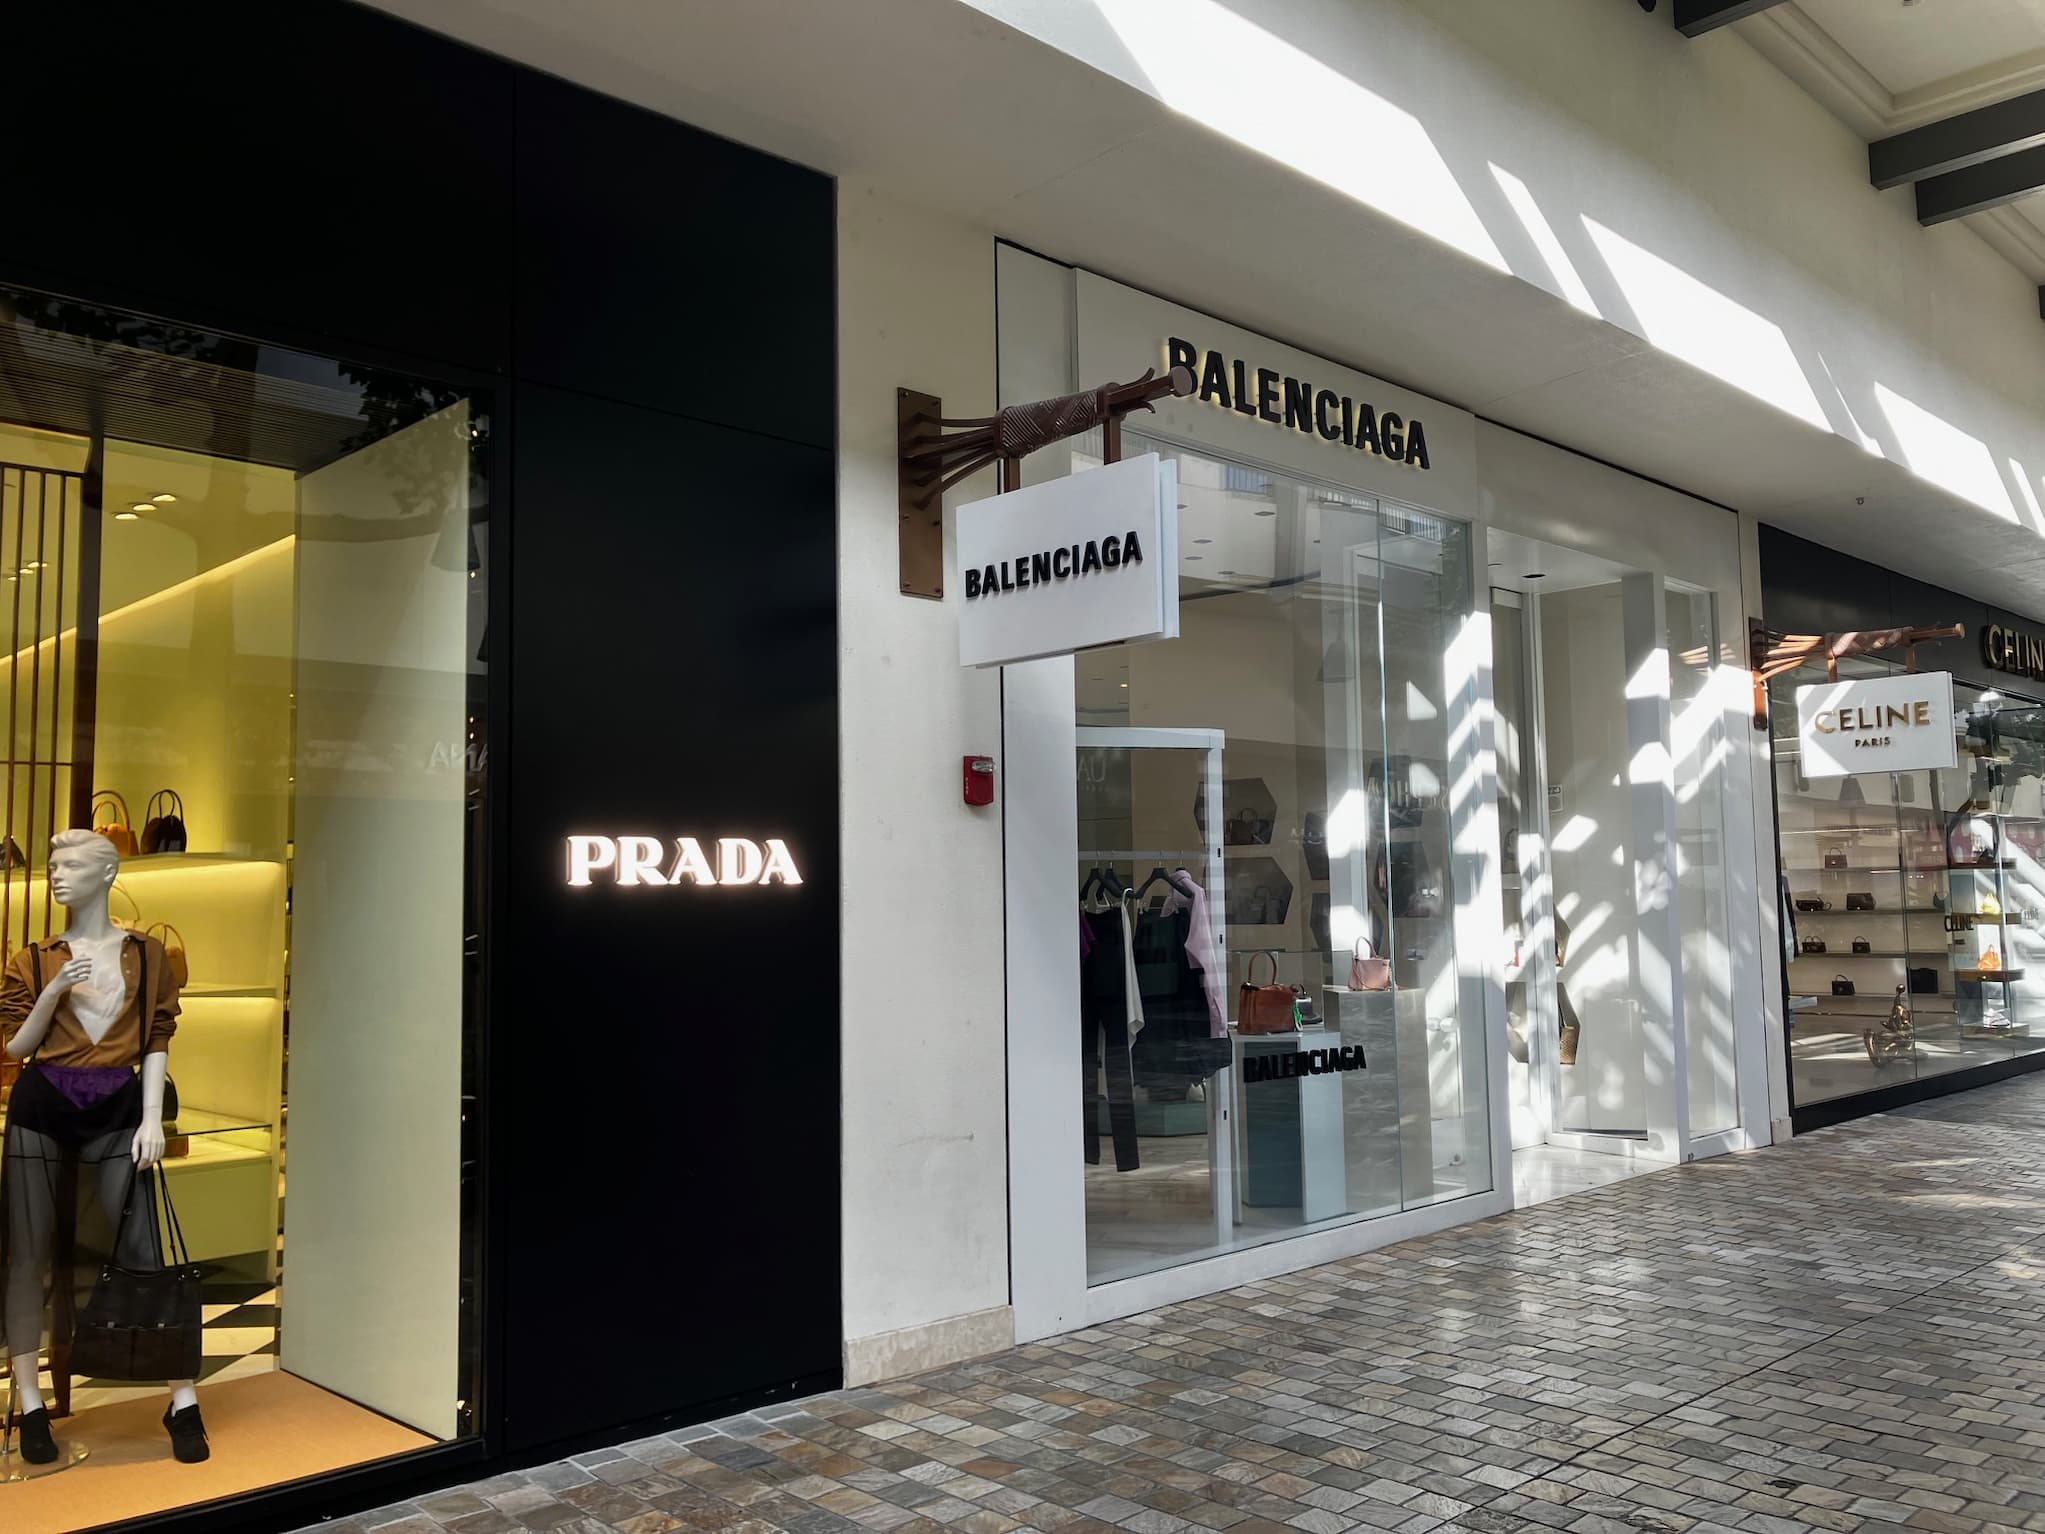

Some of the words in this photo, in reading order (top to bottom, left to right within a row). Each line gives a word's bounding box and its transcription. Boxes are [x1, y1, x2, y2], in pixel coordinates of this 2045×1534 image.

[1168, 336, 1430, 470] BALENCIAGA
[965, 531, 1143, 598] BALENCIAGA
[1814, 700, 1931, 734] CELINE
[1855, 736, 1890, 748] PARIS
[565, 836, 804, 886] PRADA
[1243, 1045, 1366, 1083] BALENCIAGA
